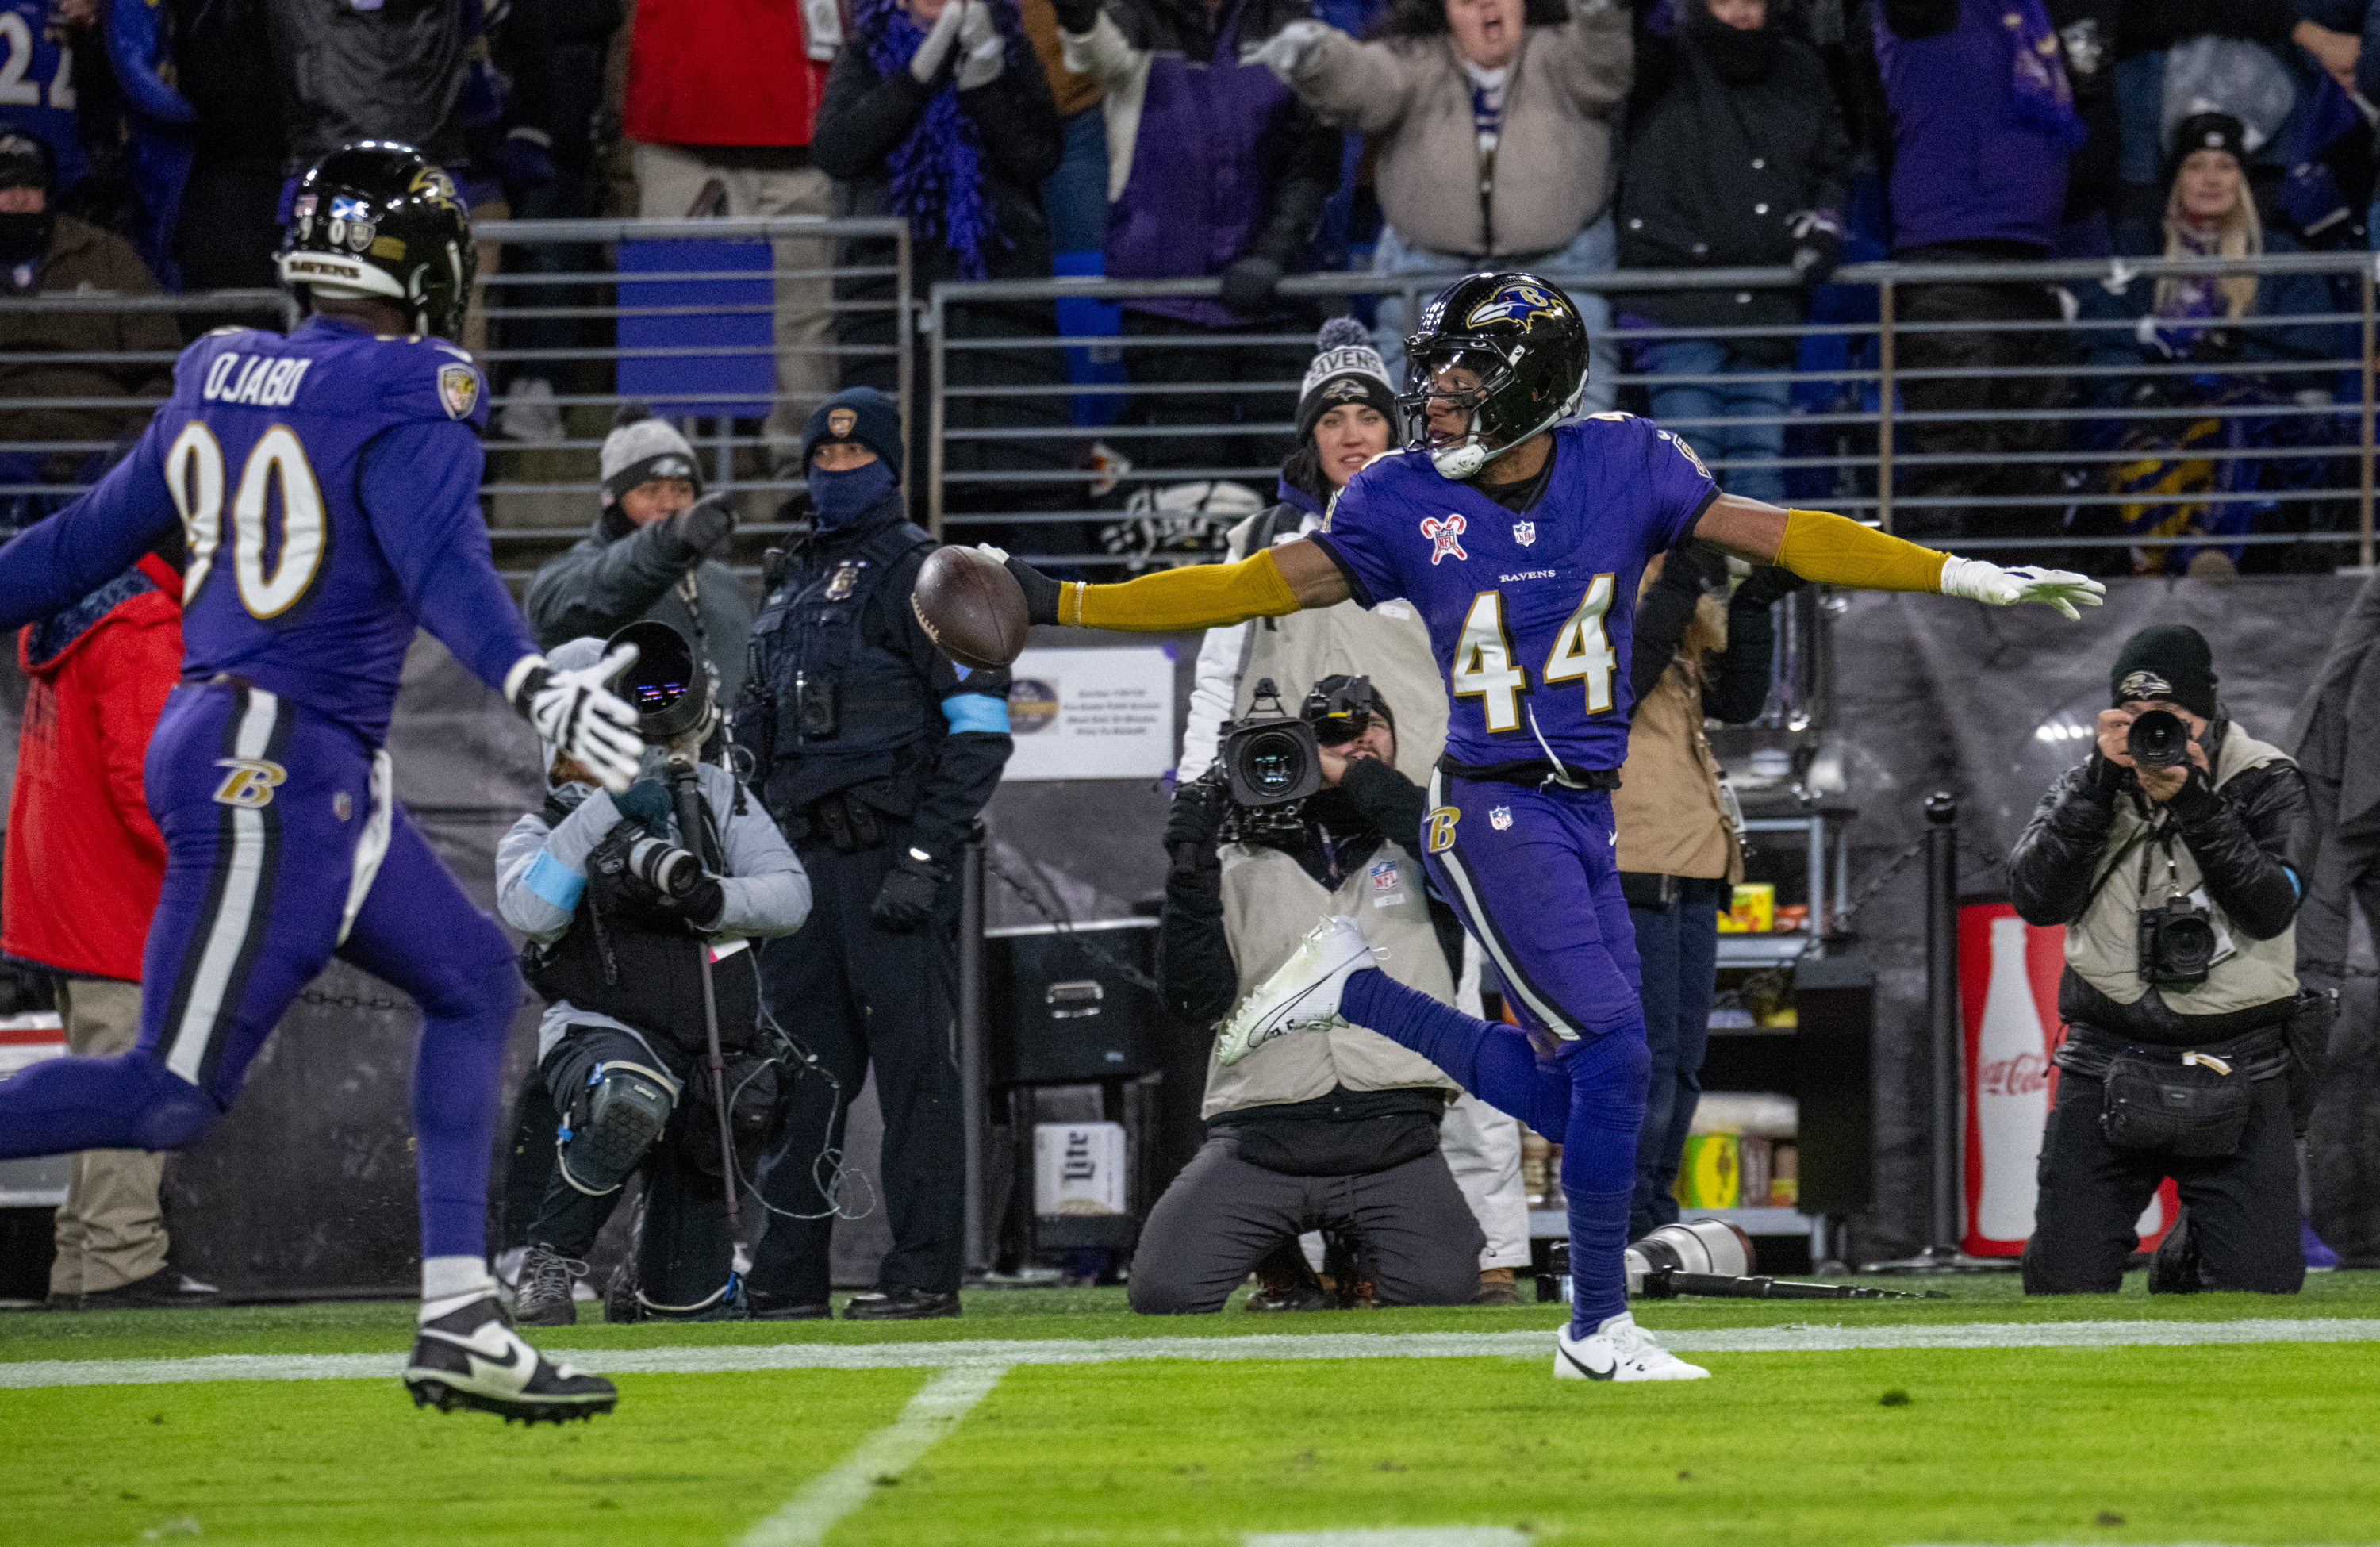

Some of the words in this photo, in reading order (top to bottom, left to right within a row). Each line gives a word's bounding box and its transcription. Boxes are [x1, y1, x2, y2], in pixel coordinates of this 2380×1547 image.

[204, 352, 313, 406] OJABO
[164, 420, 327, 620] 90
[1438, 536, 1455, 549] NFL
[1499, 570, 1556, 583] RAVENS
[1450, 571, 1617, 735] 44
[1423, 806, 1461, 854] B
[1374, 871, 1398, 888] NFL
[1063, 1131, 1096, 1182] Lite
